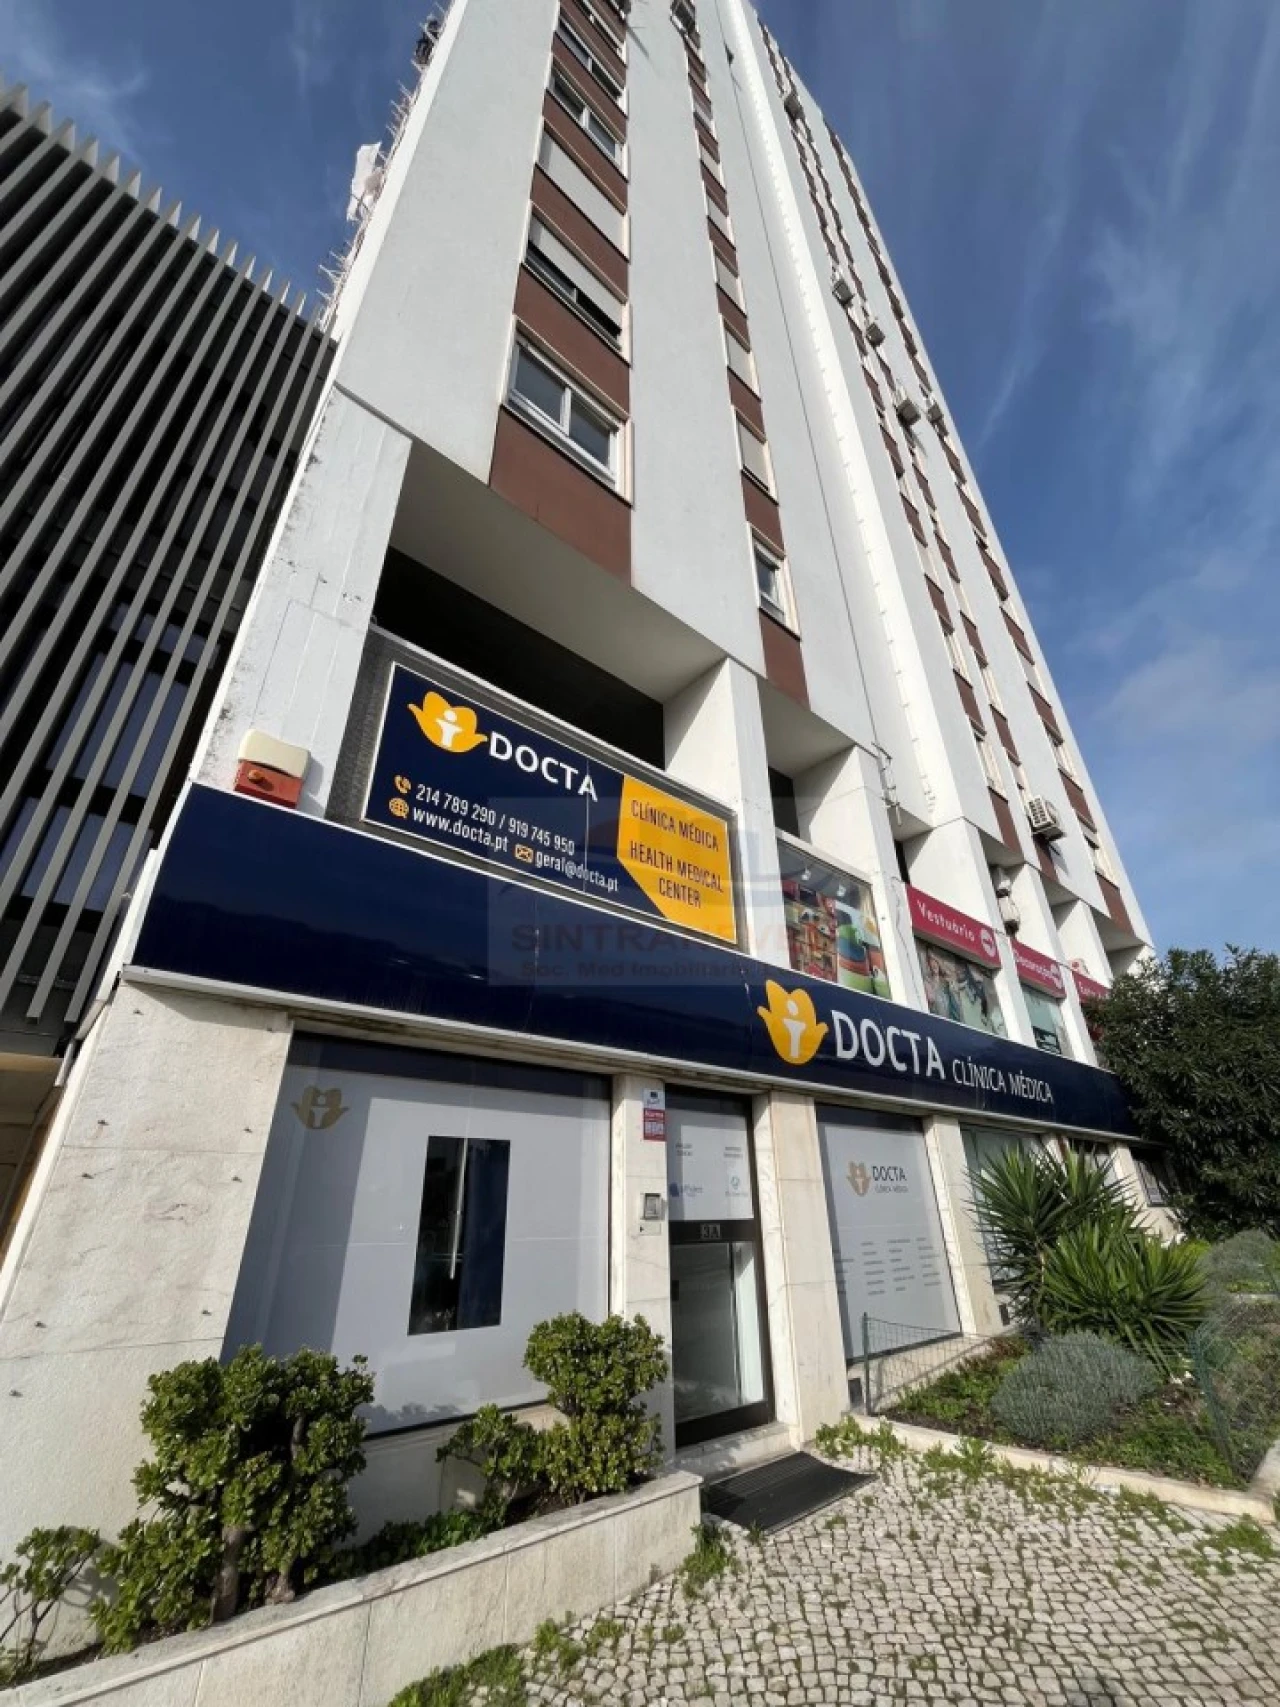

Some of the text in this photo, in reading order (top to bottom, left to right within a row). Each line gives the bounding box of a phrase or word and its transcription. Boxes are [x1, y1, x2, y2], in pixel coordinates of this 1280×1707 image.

[488, 730, 599, 802] DOCTA
[412, 806, 509, 853] www.docta.pt
[416, 784, 576, 856] 214 789 290 / 919 745 950
[631, 799, 719, 852] CLÍNICA MÉDICA
[534, 850, 619, 892] geral@docta.pt
[630, 840, 724, 893] HEALTH MEDICAL
[658, 877, 701, 909] CENTER
[830, 1009, 1055, 1104] DOCTA CLÍNICA MÉDICA
[872, 1165, 908, 1182] DOCTA
